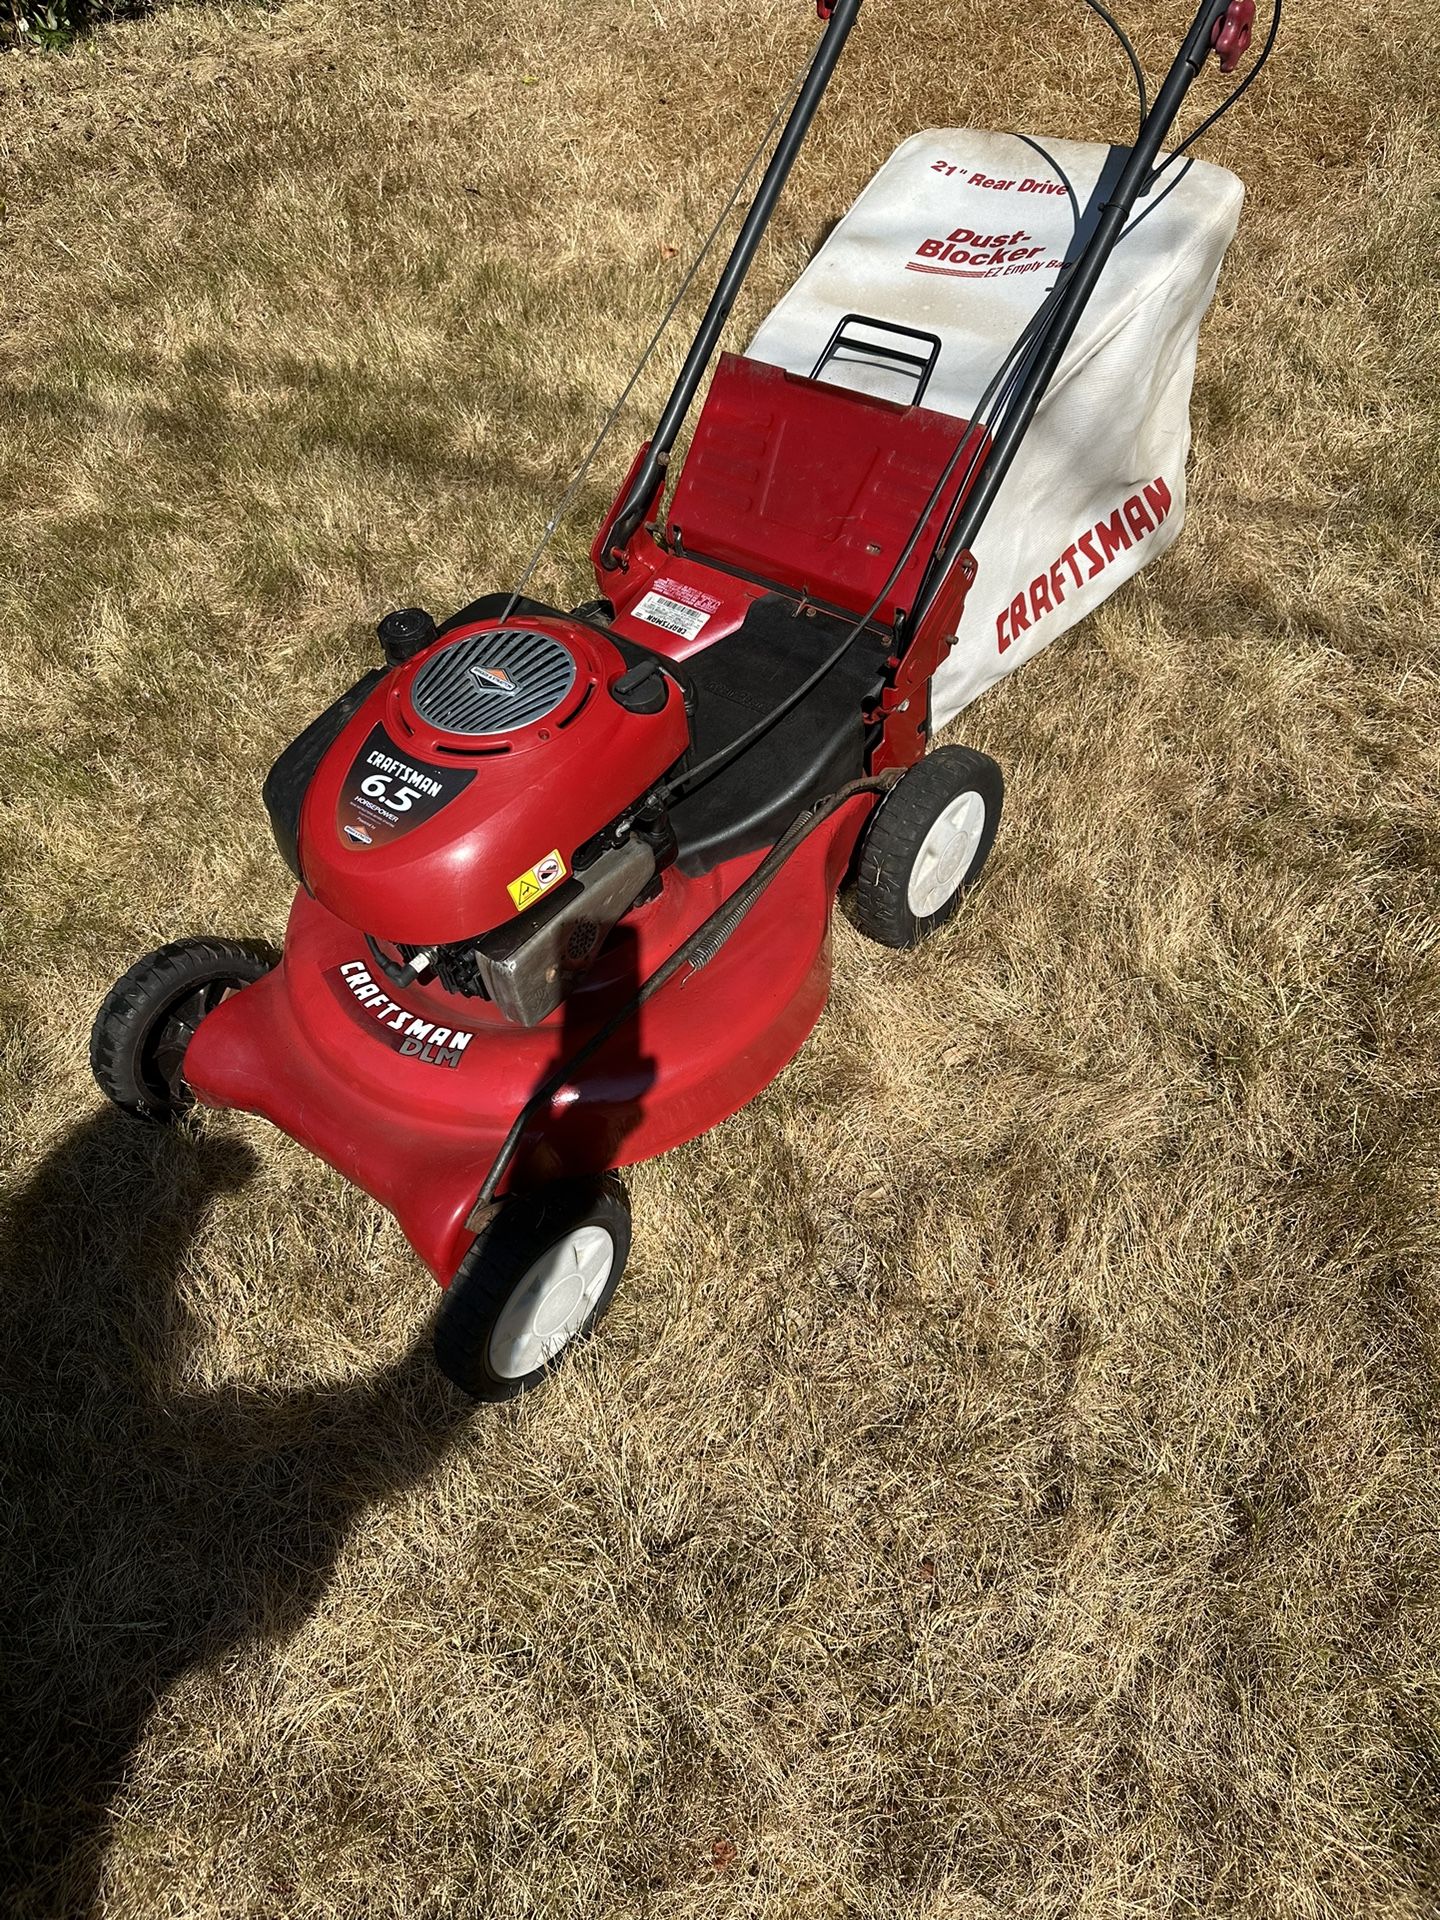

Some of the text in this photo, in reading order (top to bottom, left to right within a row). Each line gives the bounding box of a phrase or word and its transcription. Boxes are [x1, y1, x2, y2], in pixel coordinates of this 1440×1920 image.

[930, 160, 1069, 196] 21" Rear Drive
[916, 238, 1047, 266] Blocker
[946, 228, 1032, 249] Dust-
[984, 266, 1004, 279] EZ
[1003, 260, 1045, 276] Empty
[996, 476, 1172, 655] CRAFTSMAN
[646, 614, 687, 635] CRAFTSMAN
[366, 750, 443, 797] CRAFTSMAN
[360, 774, 422, 812] 6.5
[354, 795, 399, 823] HORSEPOWER
[340, 961, 473, 1051] CRAFTSMAN
[399, 1037, 463, 1068] DLM
